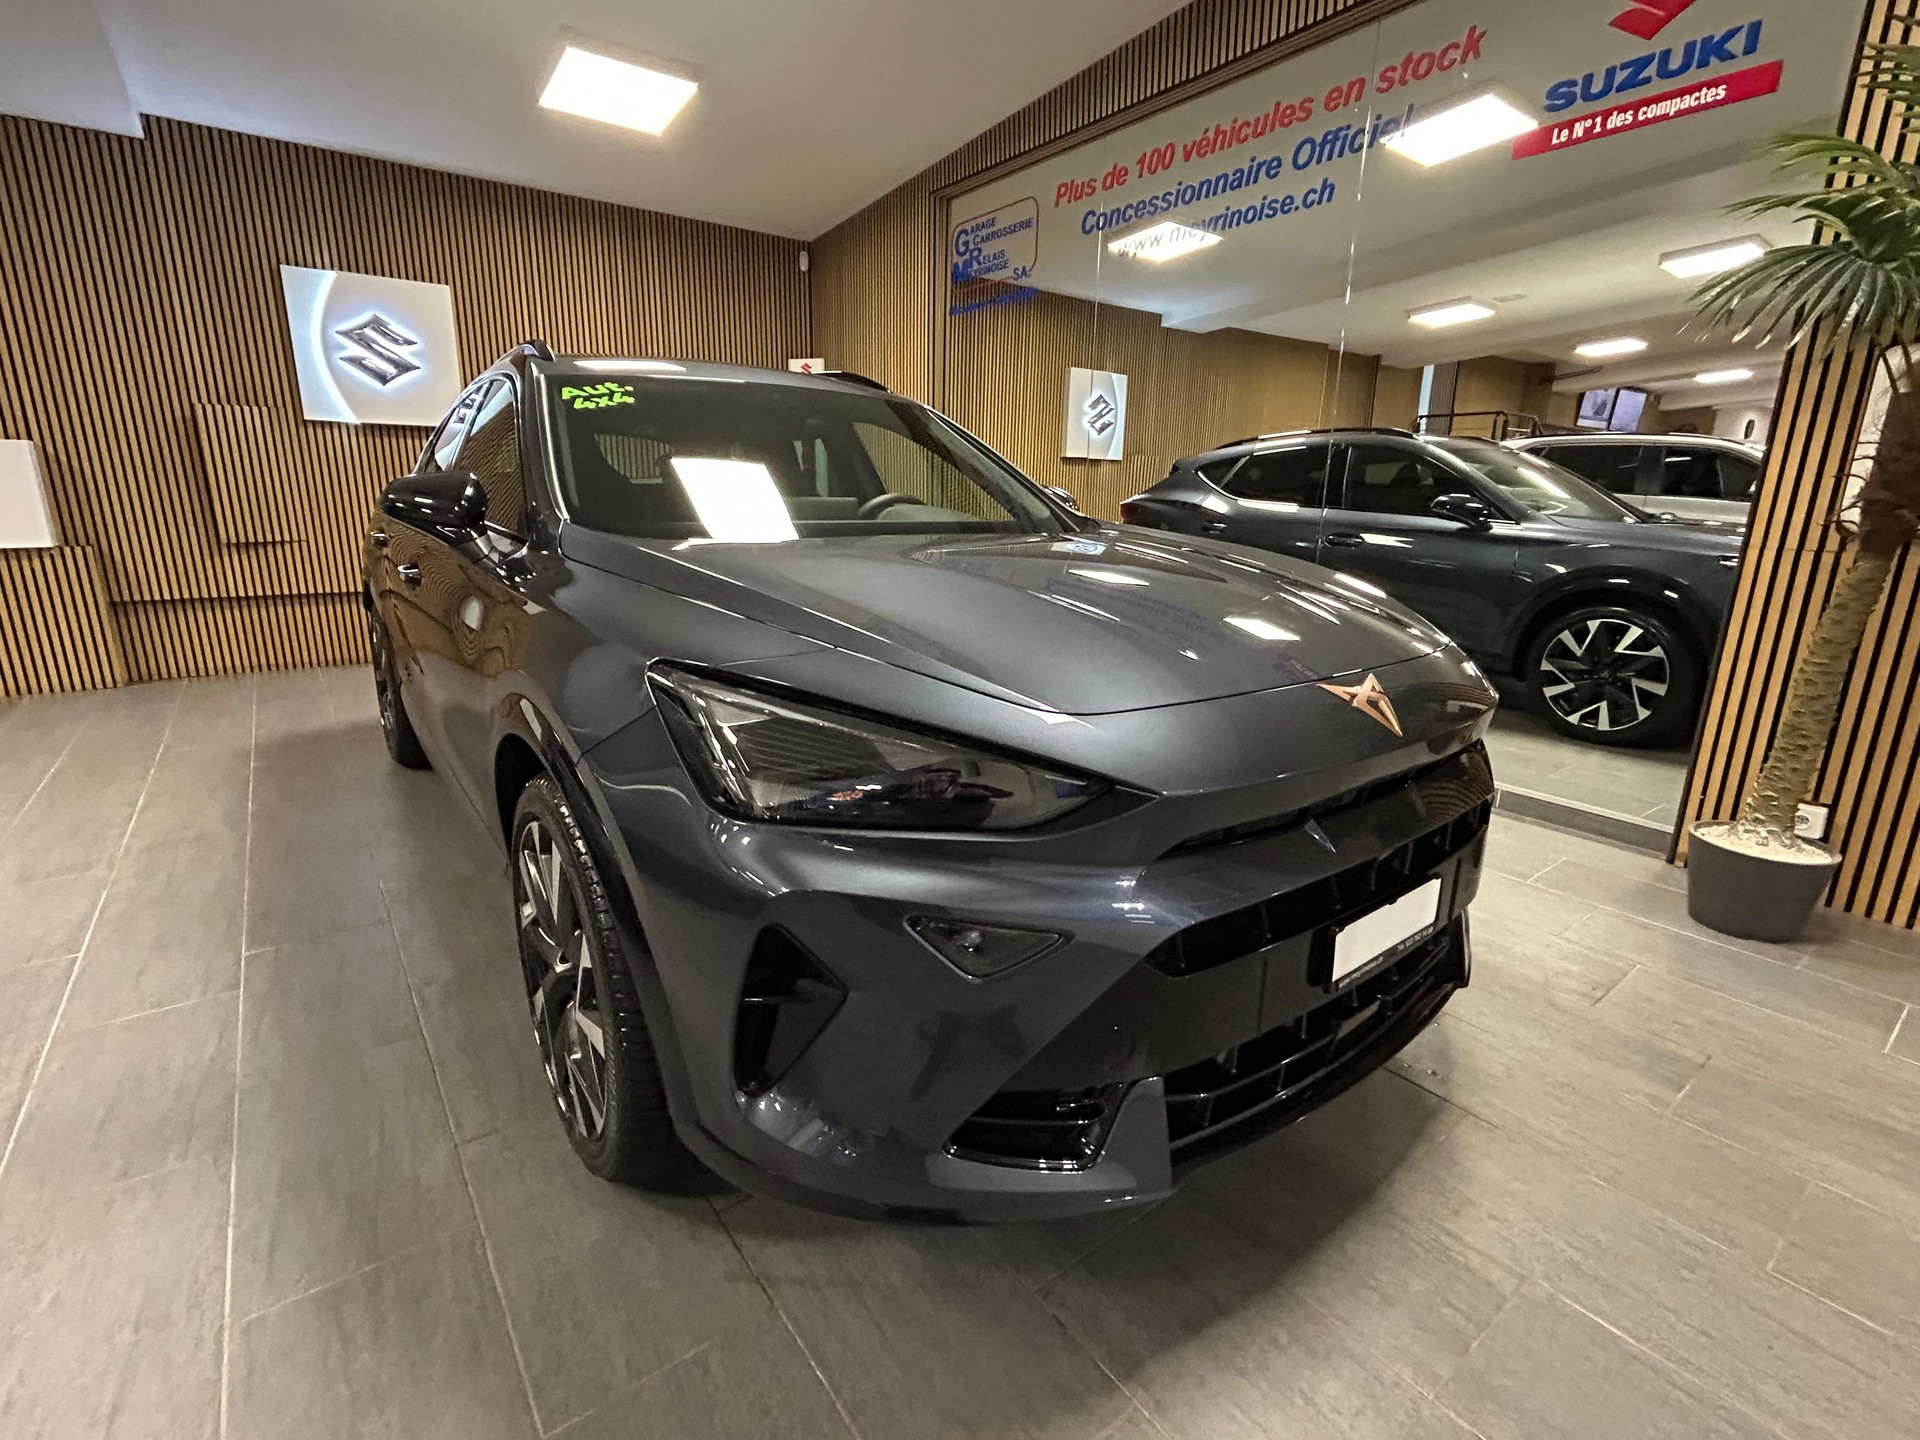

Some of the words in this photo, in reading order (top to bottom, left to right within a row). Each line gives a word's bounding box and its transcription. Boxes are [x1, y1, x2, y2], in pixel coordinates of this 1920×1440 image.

[1544, 19, 1763, 113] SUZUKI
[1054, 177, 1098, 208] Plus
[1101, 162, 1129, 191] de
[1135, 142, 1176, 179] 100
[1182, 96, 1315, 163] véhicules
[1323, 76, 1366, 112] en
[1375, 24, 1488, 94] stock
[1551, 127, 1569, 145] Le
[1607, 107, 1634, 130] des
[1637, 83, 1728, 122] compactes
[1081, 155, 1283, 236] Concessionnaire
[1291, 102, 1415, 171] Officiel
[954, 216, 997, 257] GARAGE
[972, 217, 1034, 247] CARROSSERIE
[968, 246, 1006, 269] RELAIS
[561, 382, 634, 400] Aut.
[573, 392, 635, 409] 4x4
